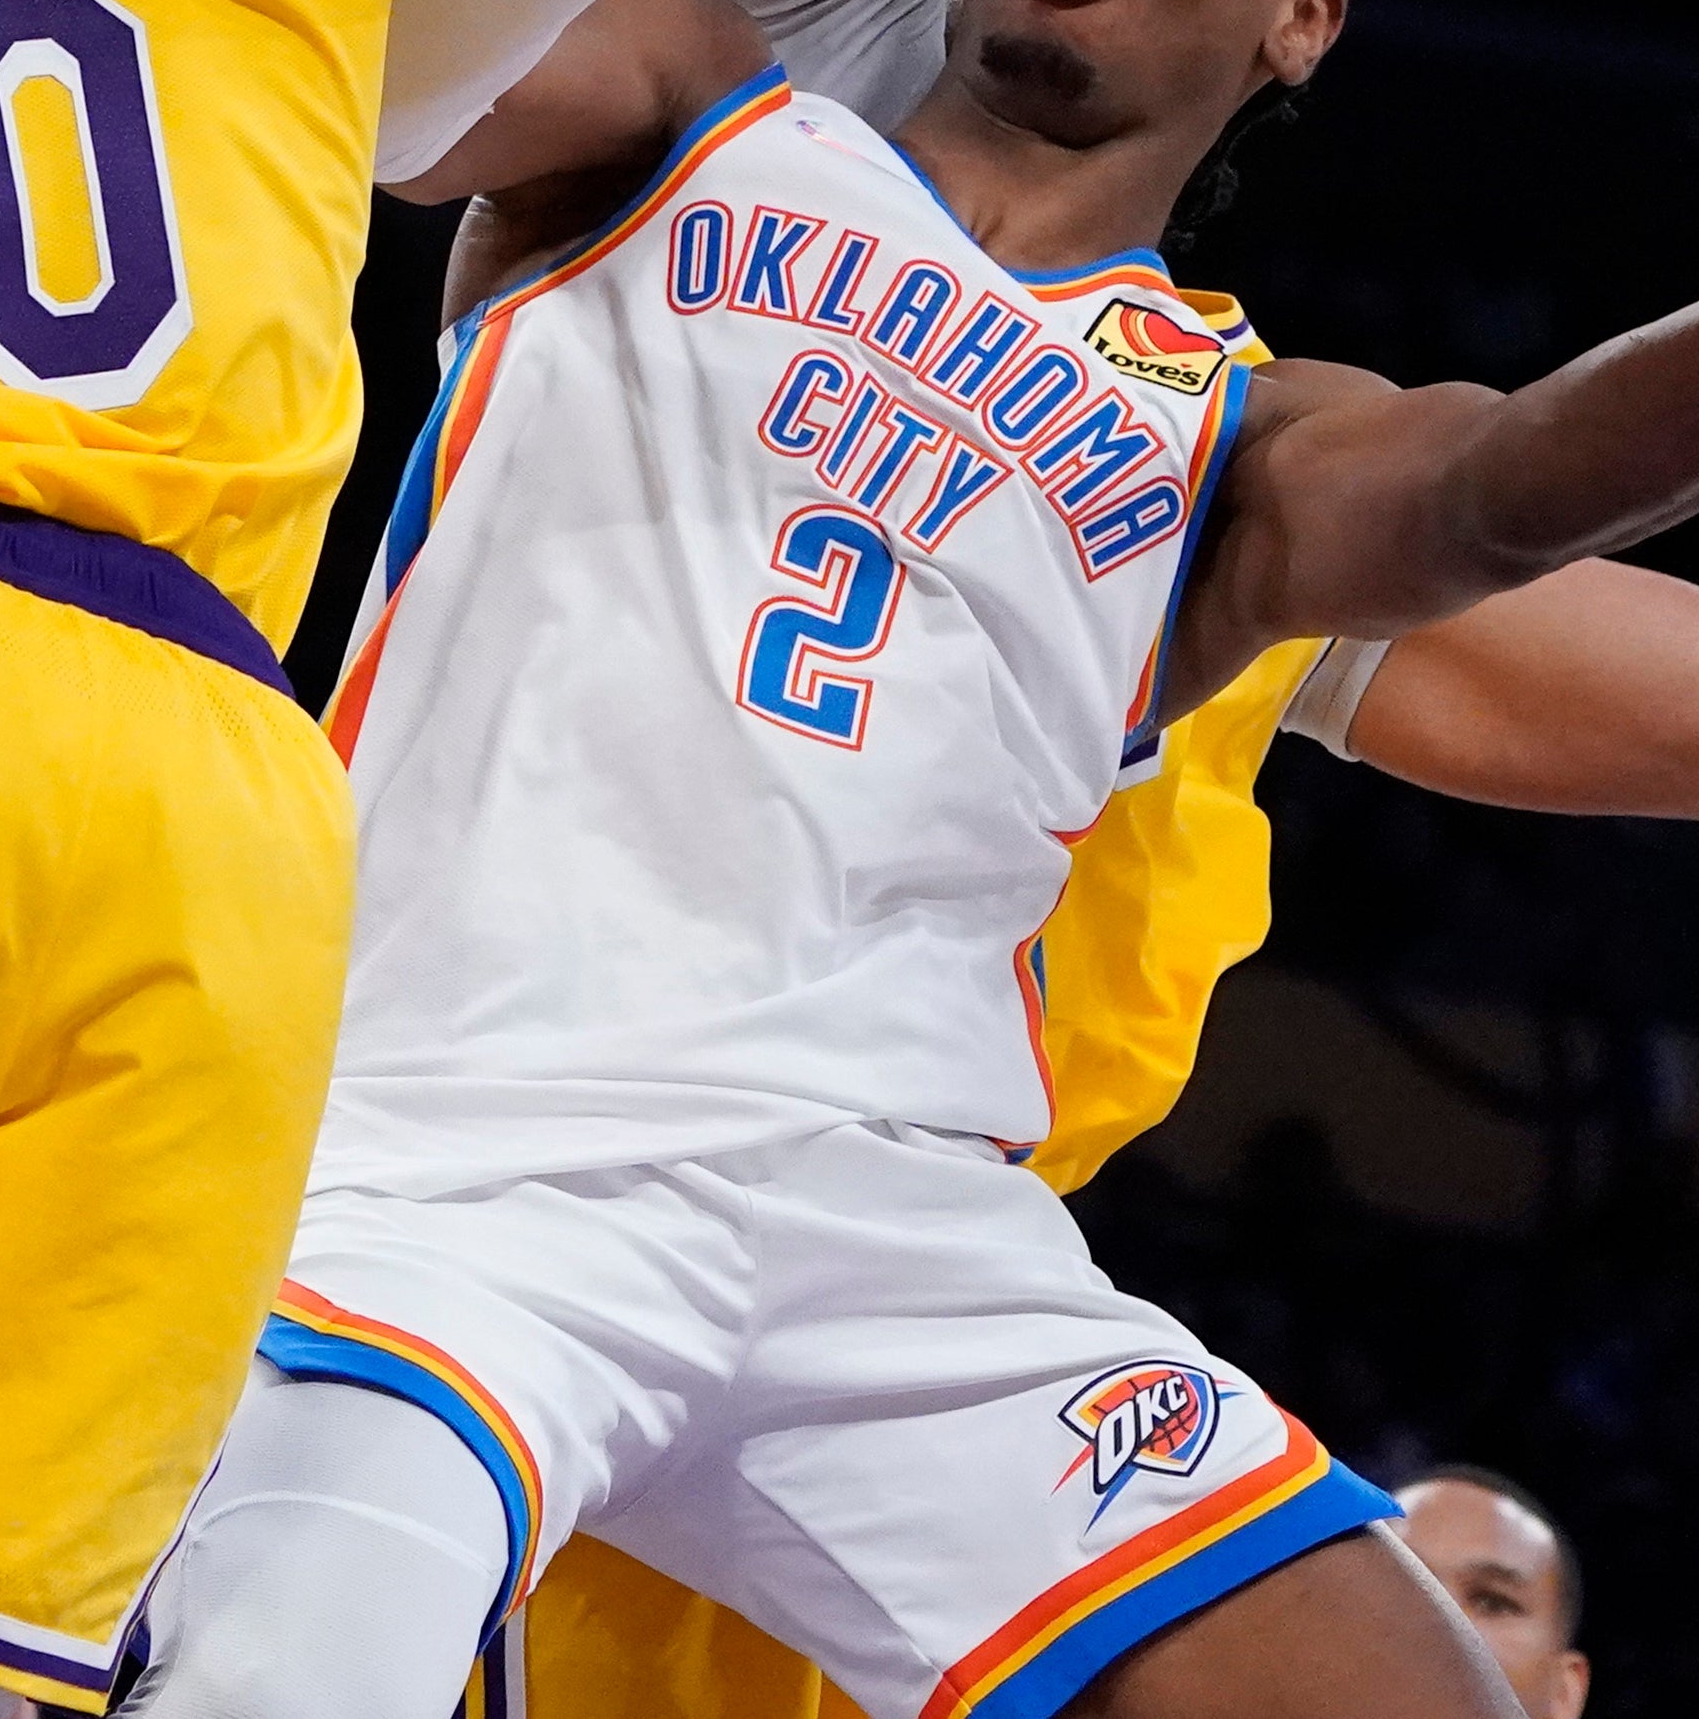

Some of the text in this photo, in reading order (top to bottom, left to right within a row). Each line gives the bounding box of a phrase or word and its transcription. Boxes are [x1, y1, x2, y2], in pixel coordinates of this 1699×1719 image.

[667, 199, 1189, 583] OKLAHOMA
[758, 349, 1014, 555] CITY
[736, 504, 905, 752] 2
[1096, 1373, 1189, 1492] OKC
